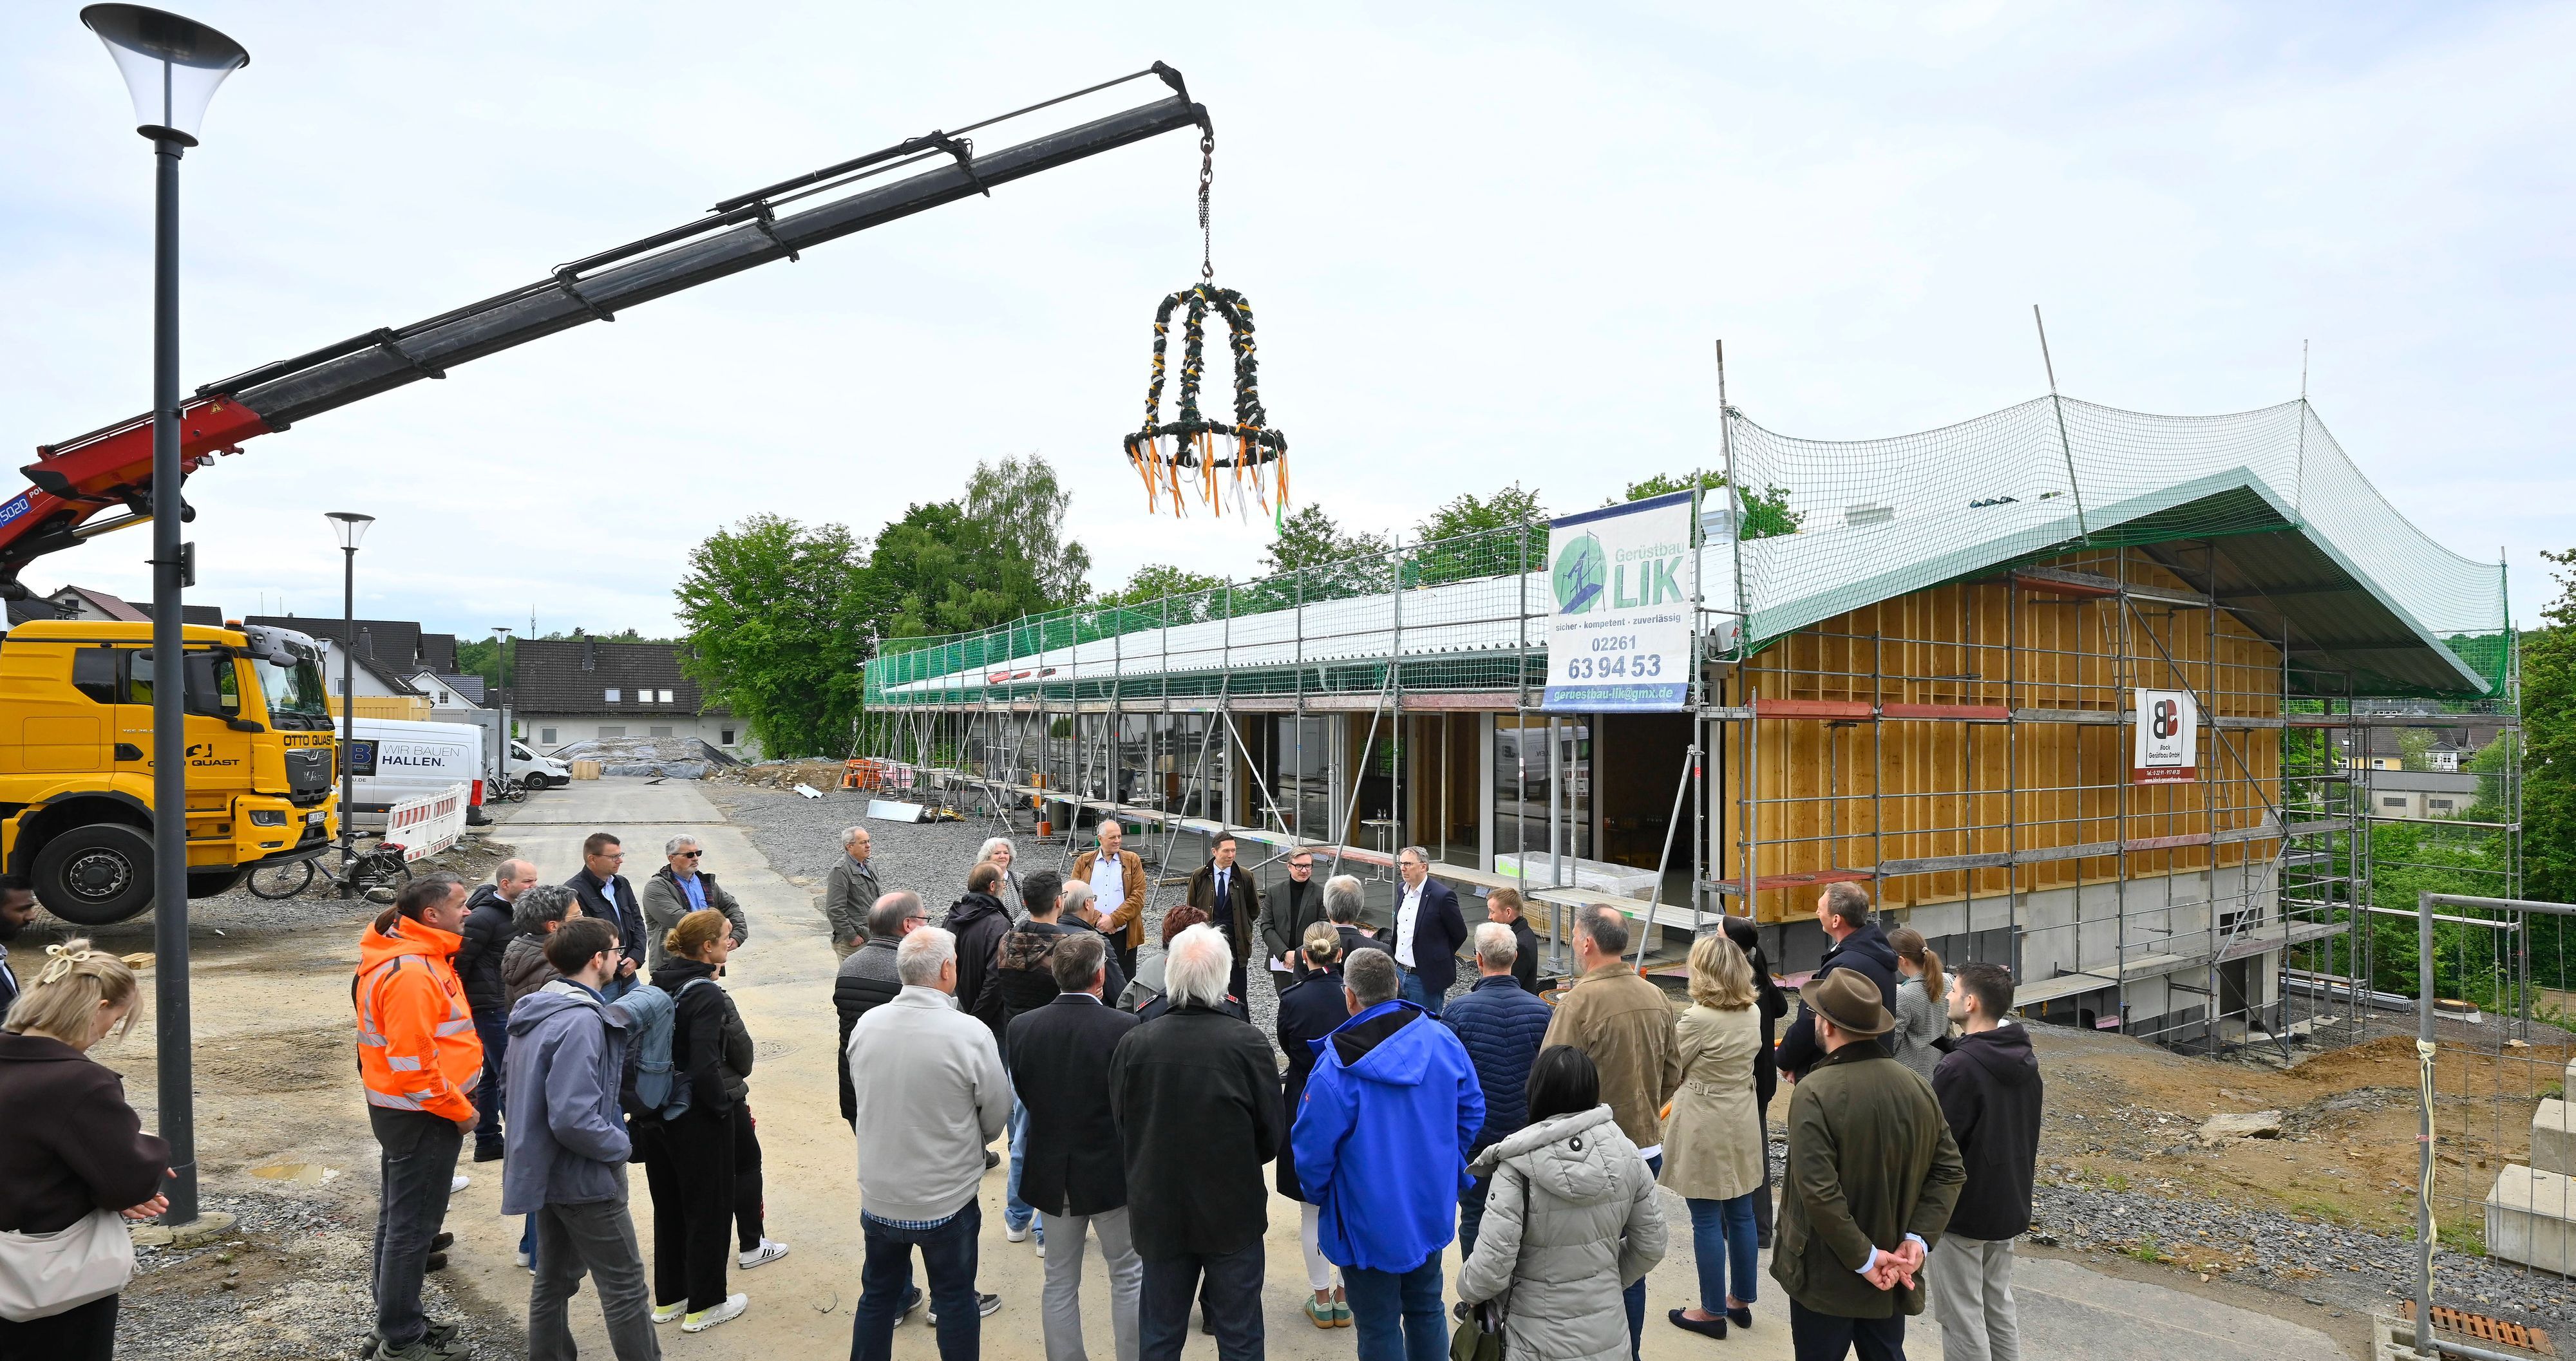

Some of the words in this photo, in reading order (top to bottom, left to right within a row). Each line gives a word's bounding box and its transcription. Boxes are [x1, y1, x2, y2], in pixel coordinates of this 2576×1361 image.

[0, 498, 28, 522] 5020
[1615, 541, 1684, 563] Gerüstbau
[1614, 556, 1685, 609] LIK
[1556, 622, 1577, 632] sicher
[1584, 619, 1625, 630] kompetent
[1633, 614, 1681, 625] zuverlässig
[1592, 635, 1636, 652] 02261
[1568, 657, 1593, 679] 63
[1598, 655, 1625, 678] 94
[1631, 653, 1662, 677] 53
[1554, 687, 1673, 702] geruestbau-lik@gmx.de
[283, 735, 309, 746] OTTO
[312, 735, 334, 746] QUAST
[384, 744, 409, 755] WIR
[414, 746, 460, 757] BAUEN
[382, 755, 445, 767] HALLEN.
